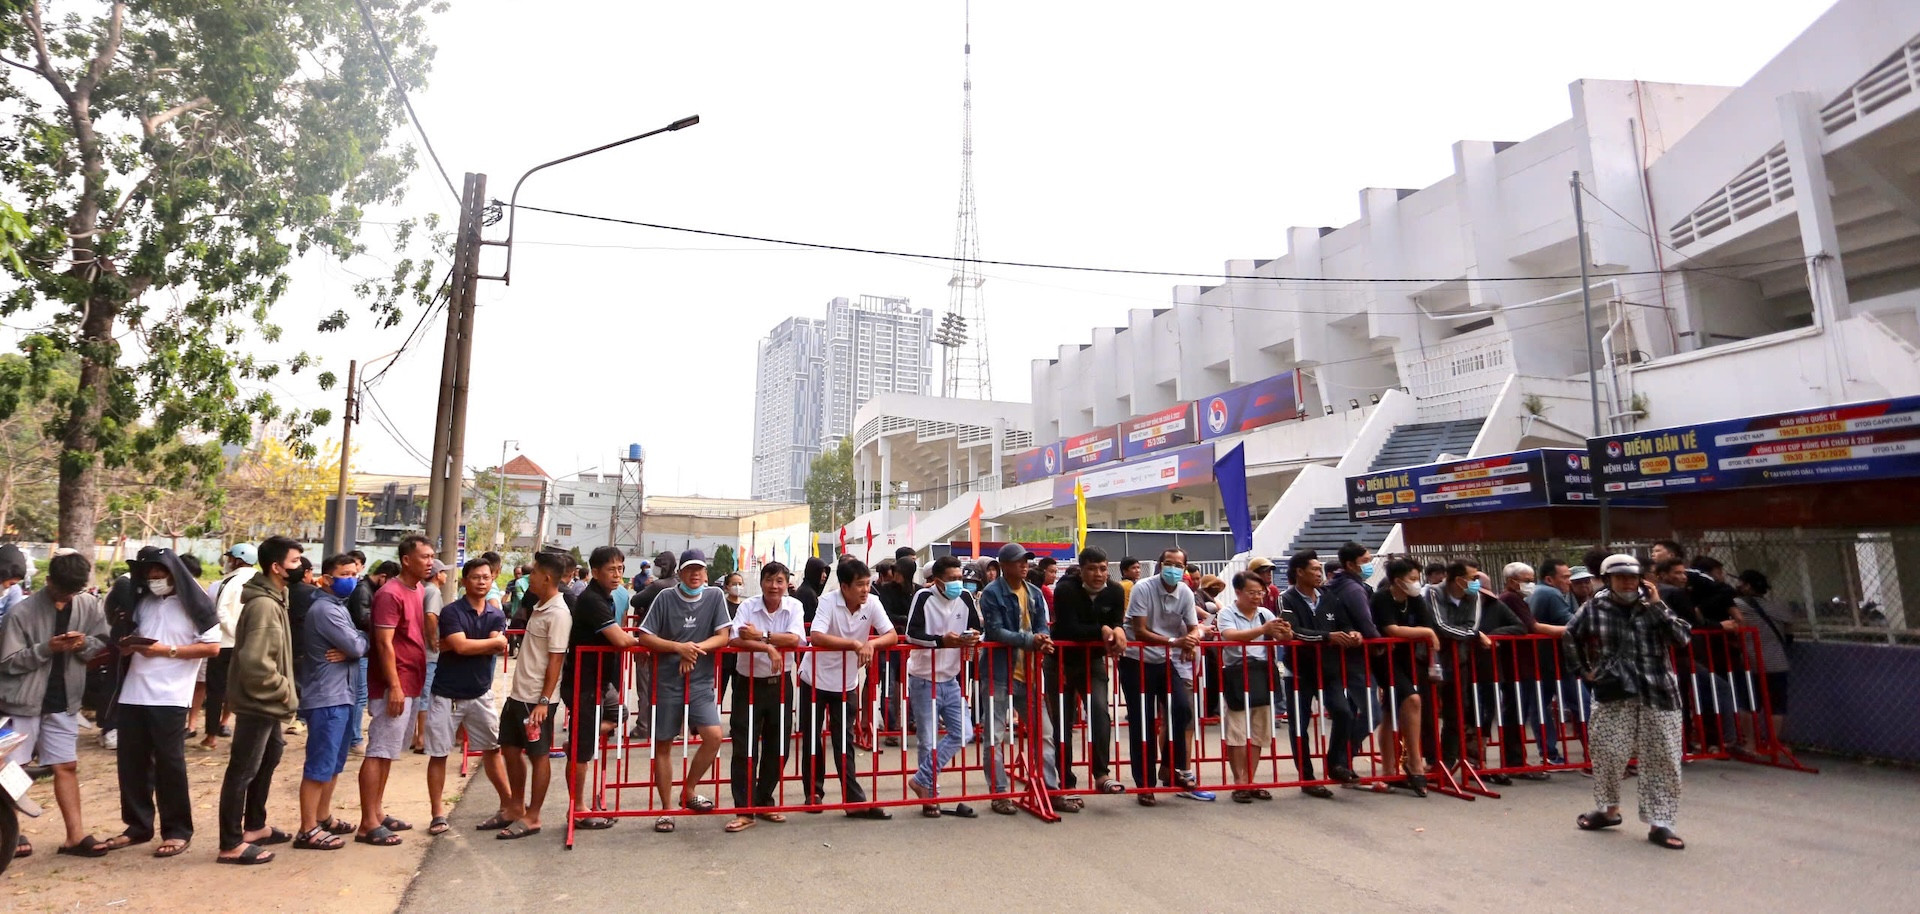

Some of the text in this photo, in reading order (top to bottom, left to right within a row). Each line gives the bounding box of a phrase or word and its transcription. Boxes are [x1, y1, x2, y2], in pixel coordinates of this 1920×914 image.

[1780, 418, 1794, 426] GIAO
[1810, 413, 1828, 423] QUỐC
[1828, 411, 1837, 420] TẾ
[1873, 416, 1912, 426] CAMPUCHIA
[1779, 428, 1799, 436] 19h30
[1805, 422, 1842, 434] 19/3/2025
[1623, 430, 1698, 456] ĐIỂM BÁN VÉ
[1788, 443, 1800, 451] CUP
[1802, 440, 1820, 450] BÓNG
[1831, 437, 1849, 447] CHÂU
[1857, 435, 1874, 444] 2027
[1642, 460, 1668, 469] 200.000
[1677, 455, 1706, 465] 400.000
[1782, 454, 1803, 462] 19h30
[1602, 461, 1637, 475] MỆNH GIÁ:
[1366, 472, 1410, 491] ĐIỂM BÁN VÉ
